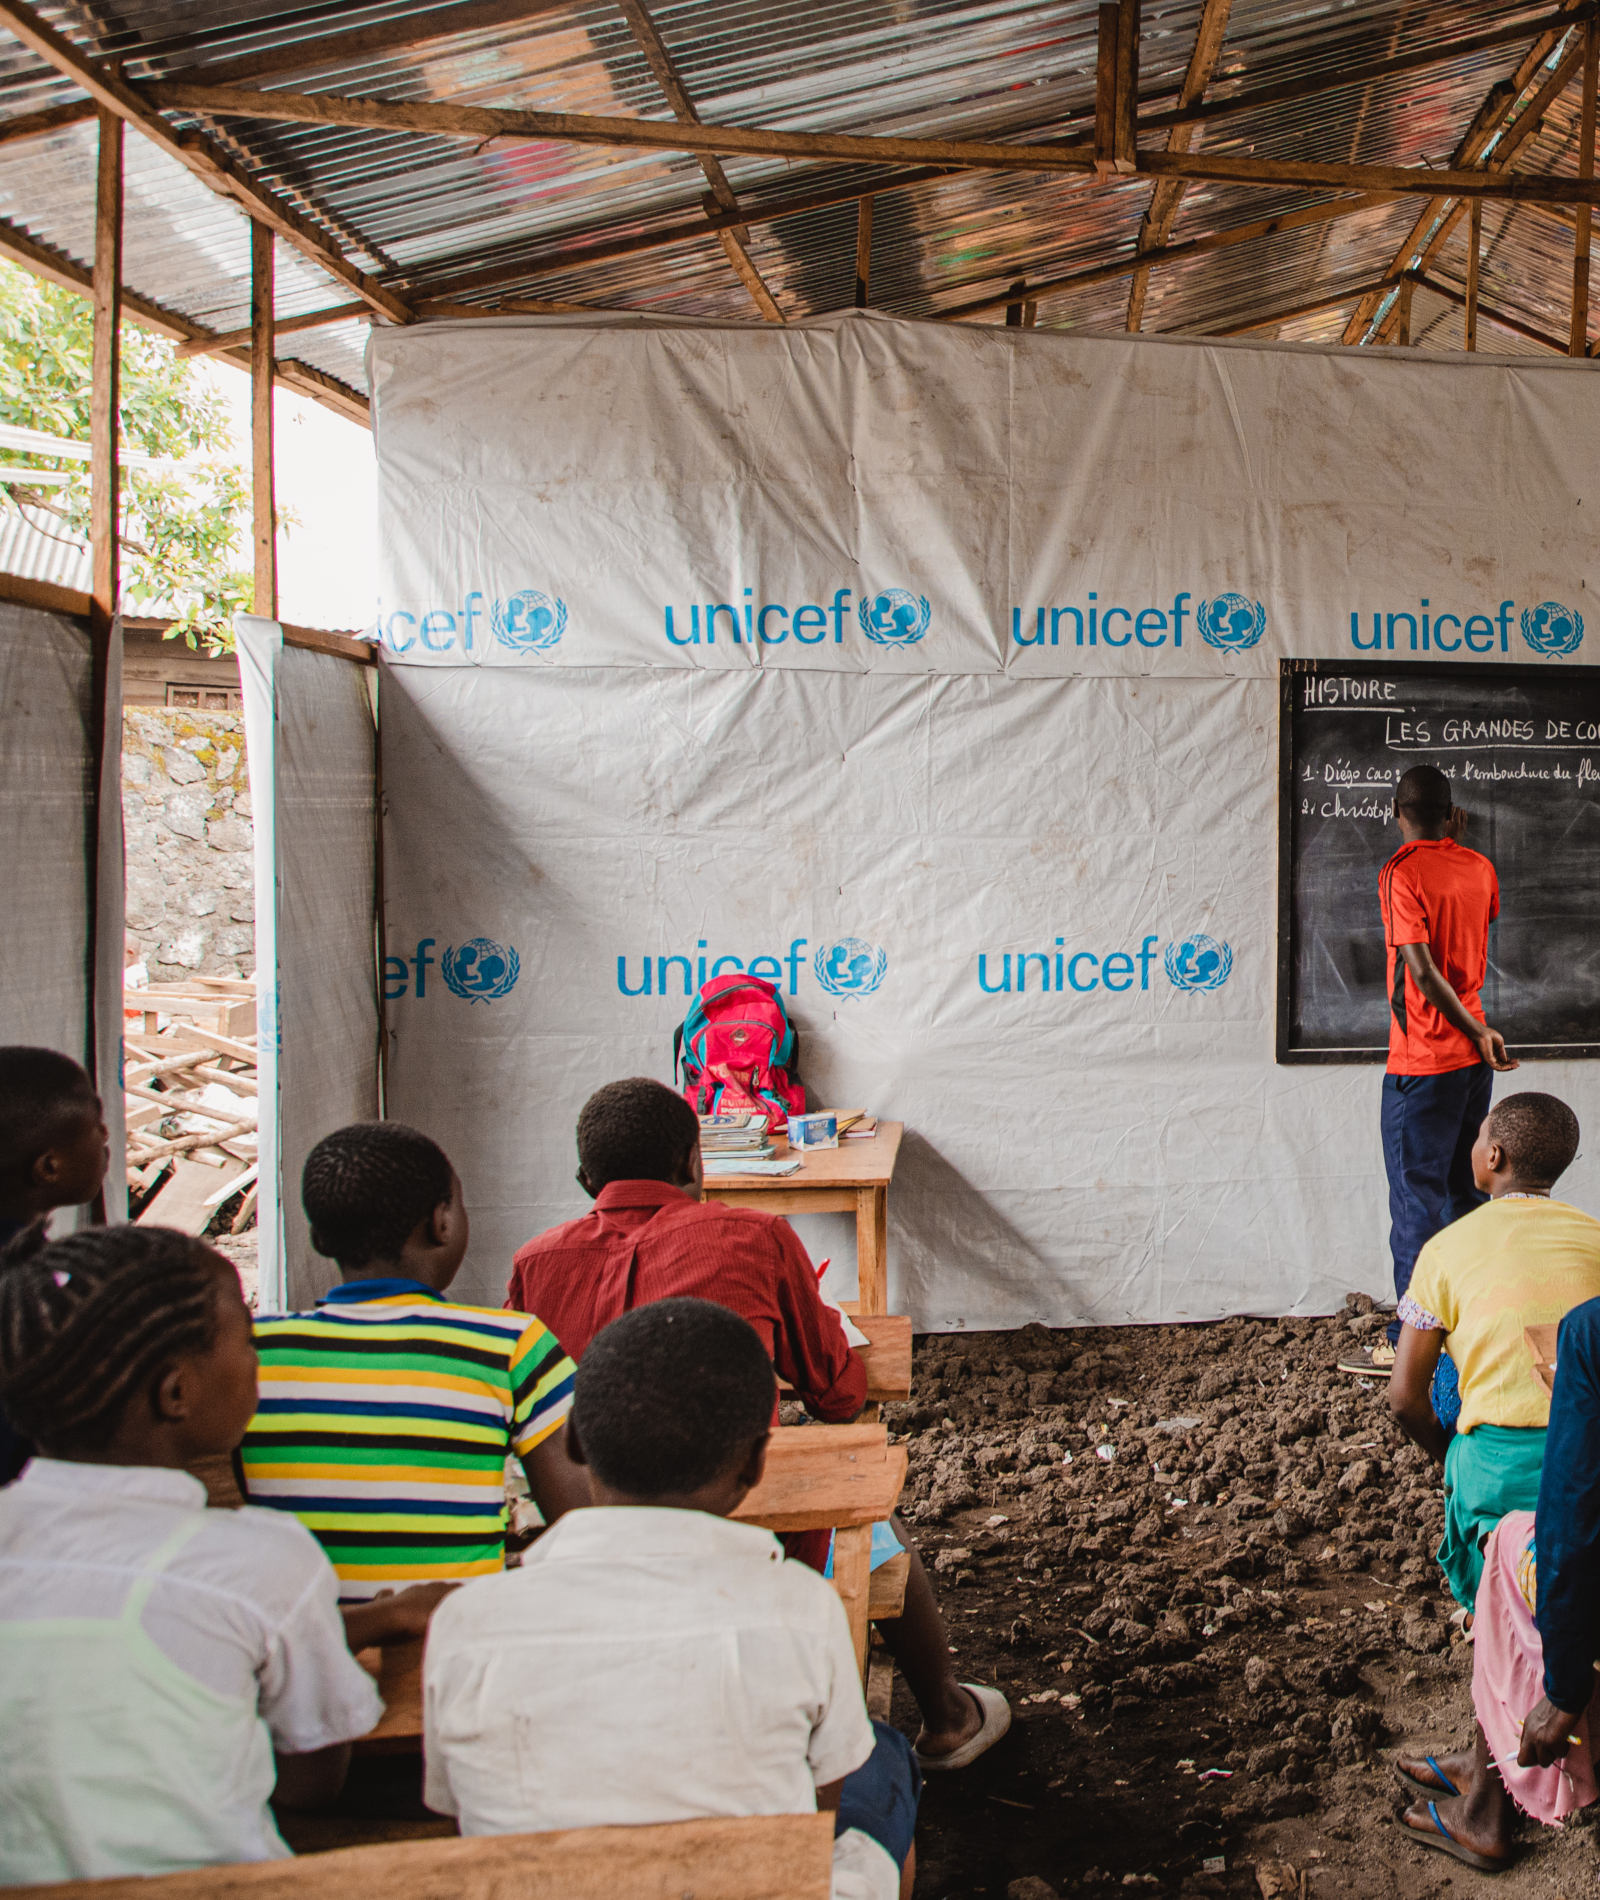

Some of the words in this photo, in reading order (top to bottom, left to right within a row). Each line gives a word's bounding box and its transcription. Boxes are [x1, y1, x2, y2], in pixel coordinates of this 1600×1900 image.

[665, 588, 852, 646] unicef
[1012, 592, 1192, 648] unicef
[1350, 599, 1515, 653] unicef
[1303, 676, 1397, 706] HISTOIRE
[1385, 716, 1431, 745] LES
[1443, 718, 1534, 742] GRANDES
[1553, 762, 1572, 781] du
[978, 936, 1159, 994] unicef
